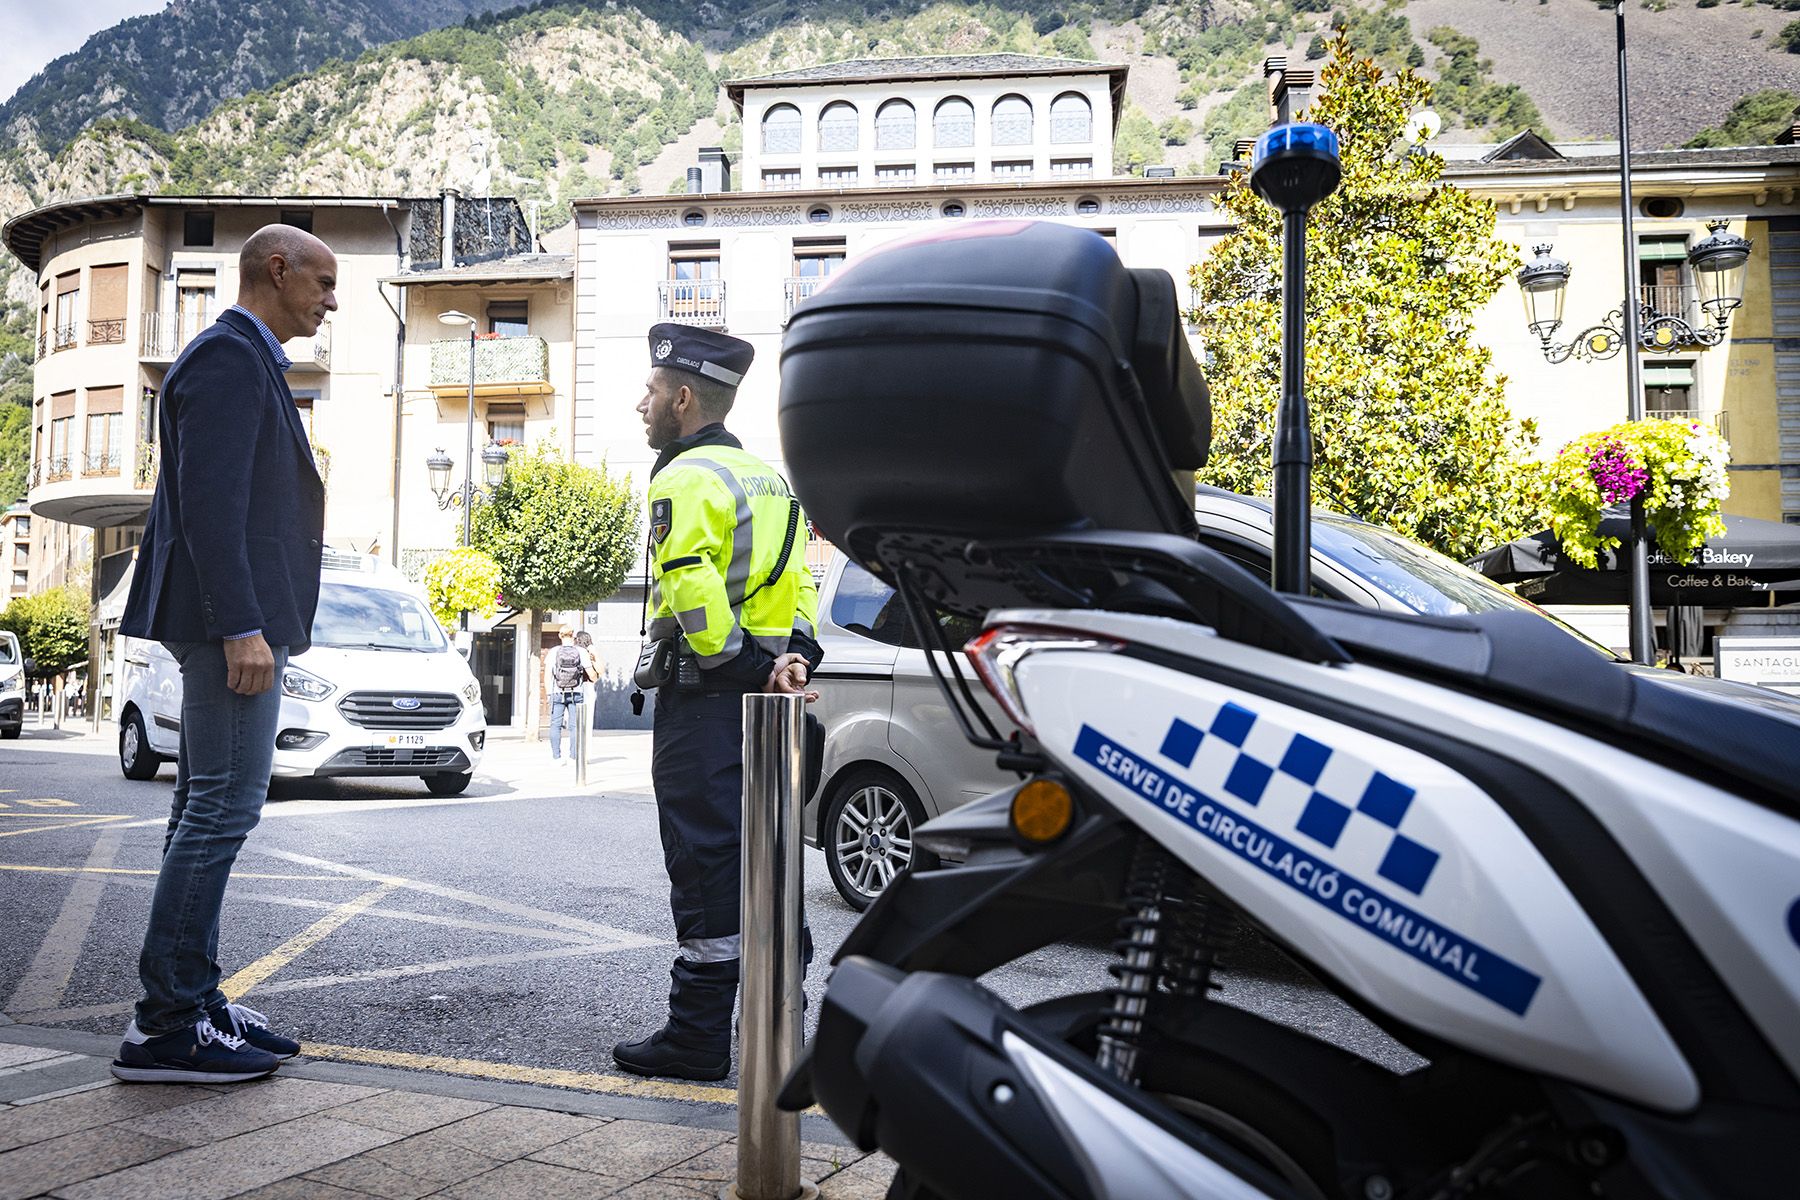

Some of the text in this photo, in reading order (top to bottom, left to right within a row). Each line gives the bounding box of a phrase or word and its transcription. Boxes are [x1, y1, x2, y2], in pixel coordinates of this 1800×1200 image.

[1702, 547, 1754, 567] Bakery
[1667, 574, 1709, 588] Coffee
[1711, 574, 1724, 587] &
[398, 735, 424, 744] P 1129
[1096, 744, 1481, 983] SERVEI DE CIRCULACIÓ COMUNAL
